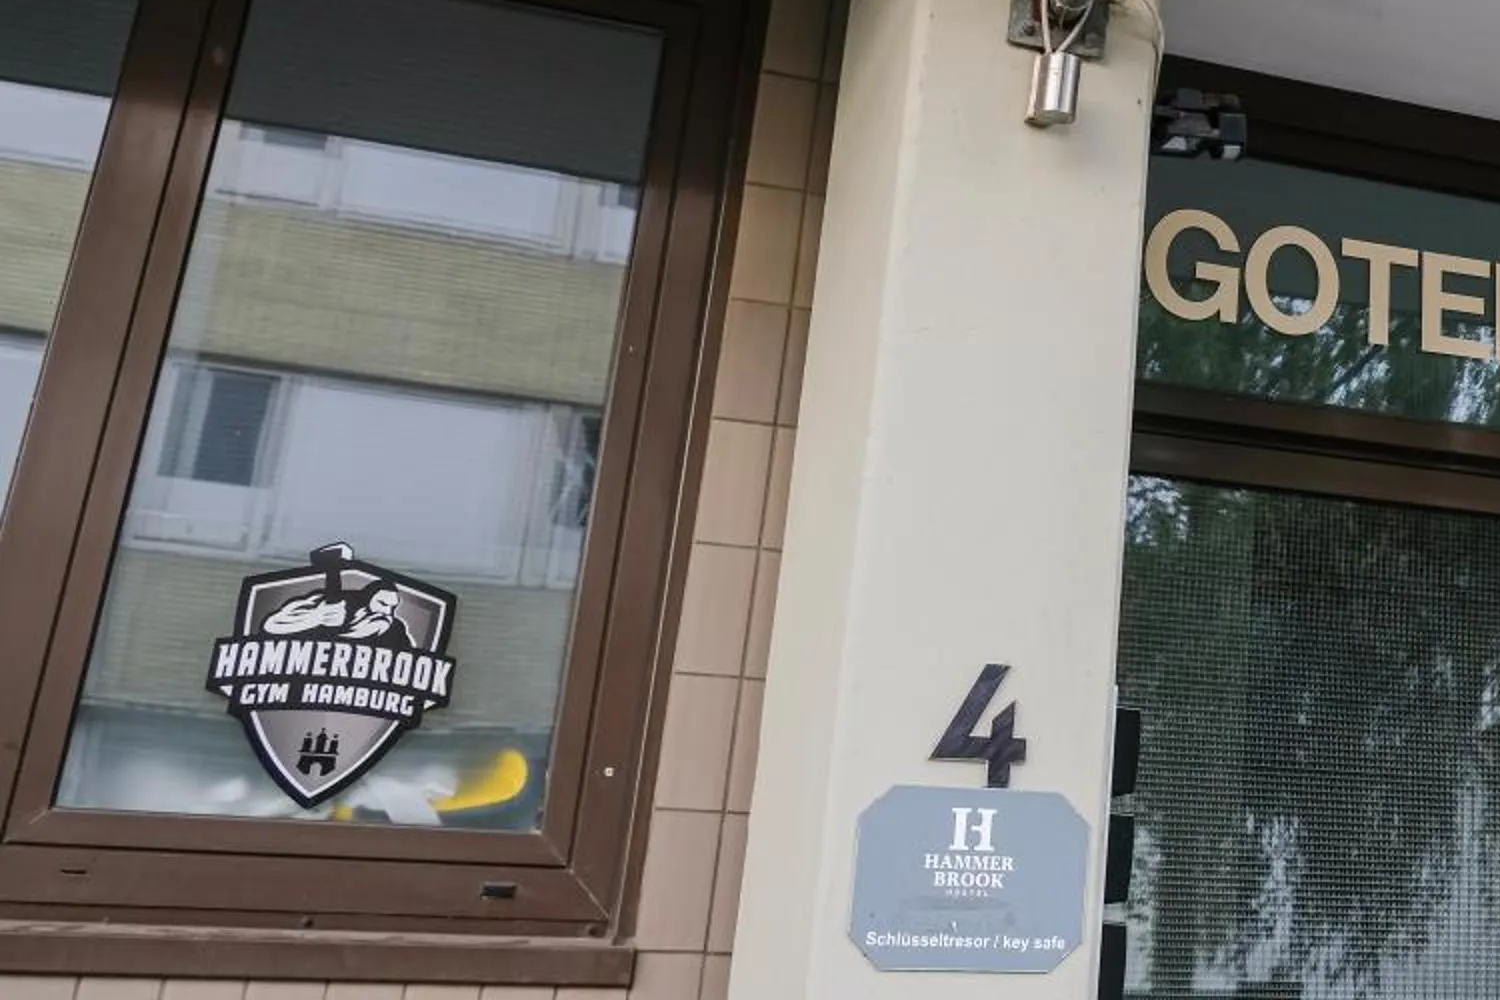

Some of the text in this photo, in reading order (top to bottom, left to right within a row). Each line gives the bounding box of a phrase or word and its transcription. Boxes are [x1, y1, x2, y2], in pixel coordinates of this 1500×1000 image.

[214, 639, 452, 697] HAMMERBROOK
[239, 682, 416, 718] GYM HAMBURG
[928, 663, 1027, 788] 4
[924, 853, 1015, 872] HAMMER
[934, 871, 1005, 889] BROOK
[1003, 934, 1030, 953] key
[1033, 935, 1066, 950] safe
